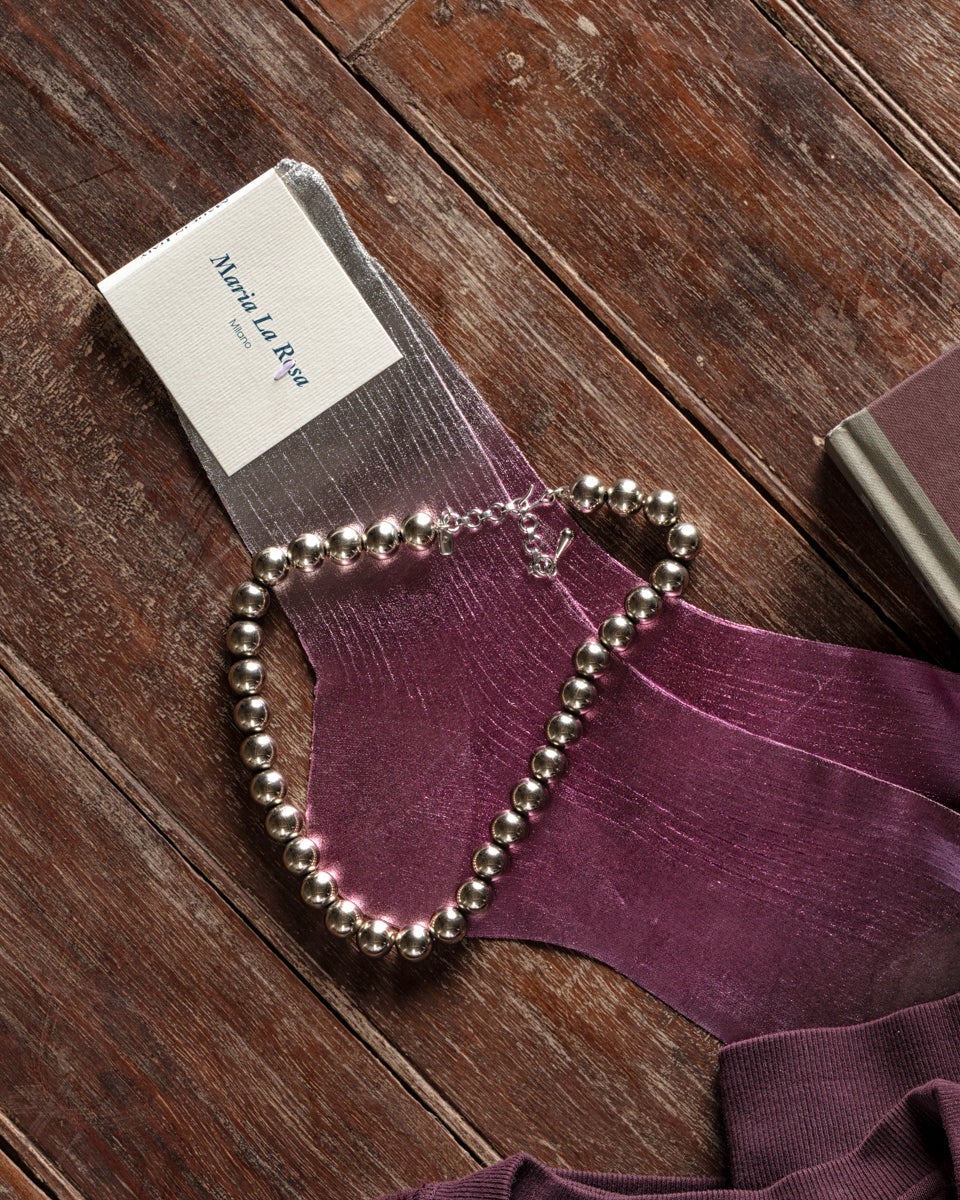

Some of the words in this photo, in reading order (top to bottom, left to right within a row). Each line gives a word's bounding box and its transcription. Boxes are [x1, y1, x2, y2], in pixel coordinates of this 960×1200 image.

[209, 253, 257, 313] Maria
[252, 313, 277, 341] La
[229, 319, 251, 349] Milano
